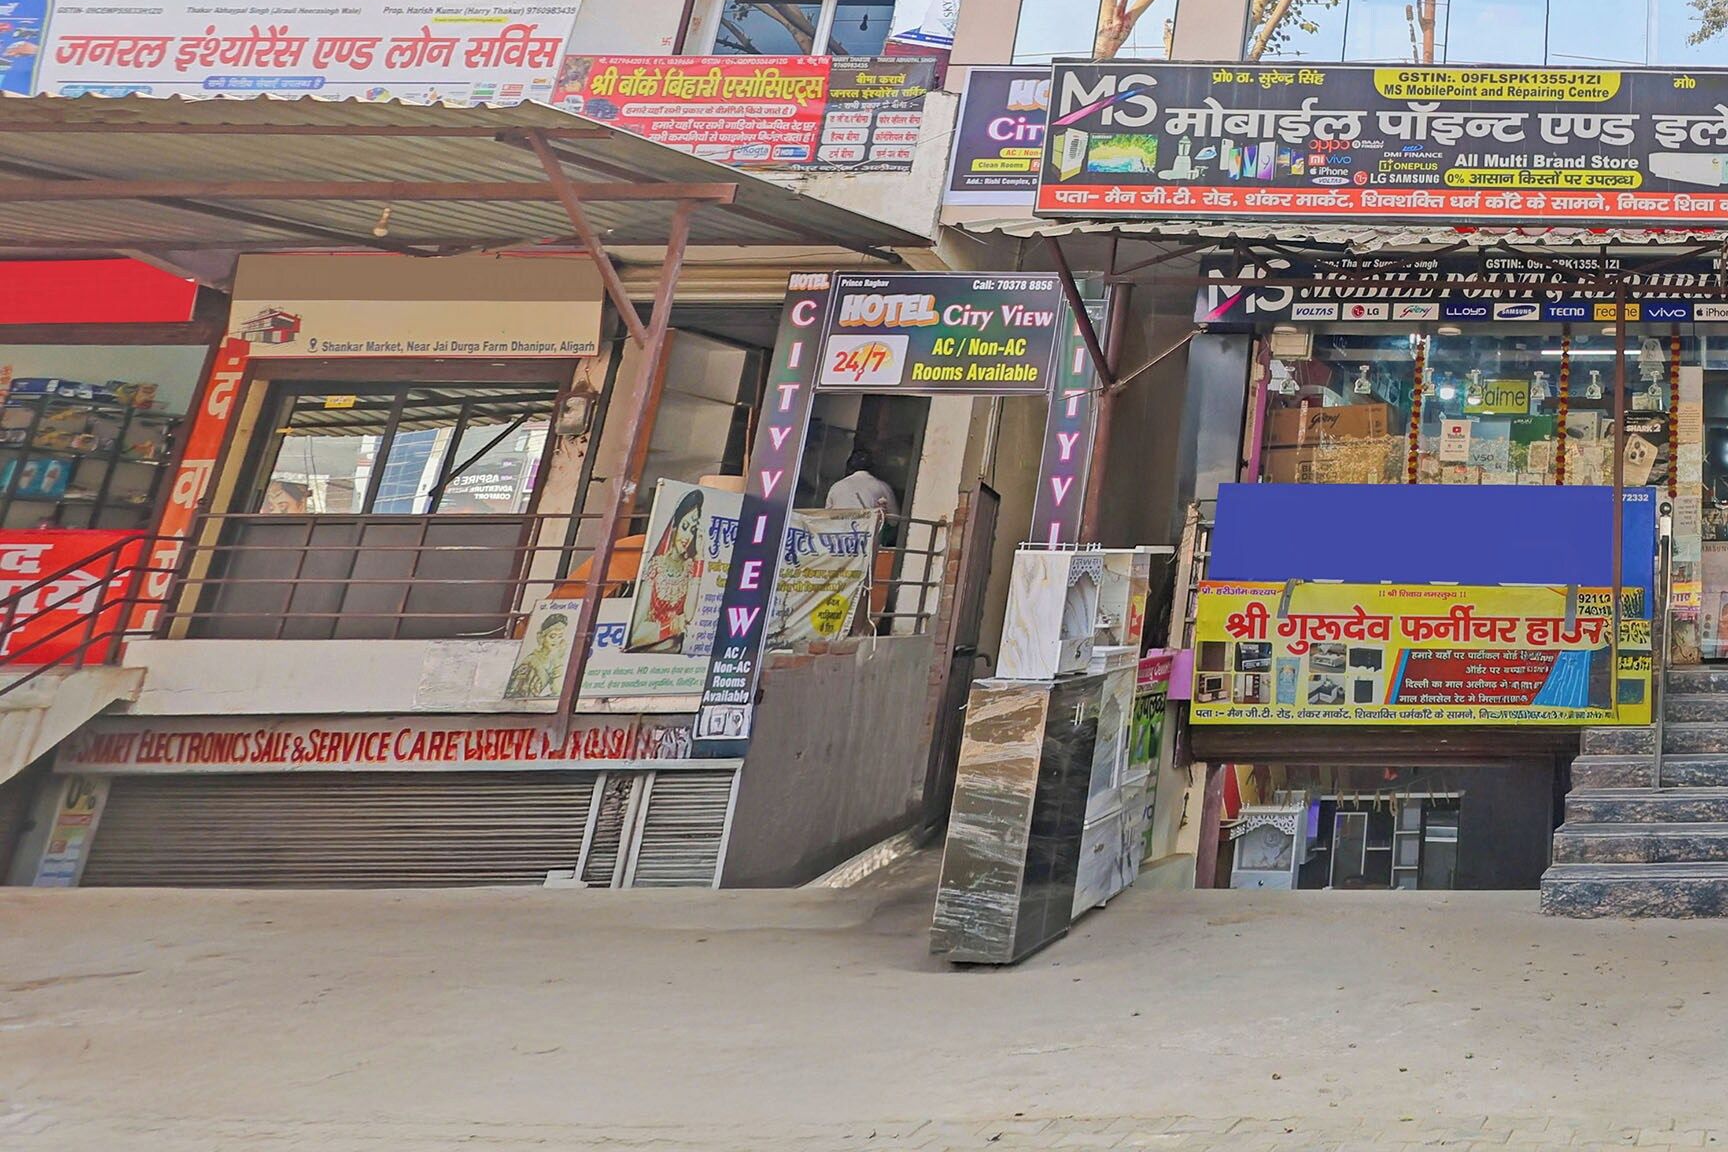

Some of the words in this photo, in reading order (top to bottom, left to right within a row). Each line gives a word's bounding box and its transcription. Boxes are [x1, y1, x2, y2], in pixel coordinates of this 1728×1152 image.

[383, 7, 404, 16] Prop.
[435, 7, 463, 15] Kumar
[493, 7, 526, 16] Thakur)
[55, 35, 175, 68] जनरल
[313, 36, 383, 70] एण्ड
[385, 24, 460, 70] लोन
[463, 23, 563, 69] सर्विस
[591, 66, 617, 96] श्री
[1298, 70, 1325, 85] सिंह
[1384, 84, 1402, 95] MS
[1406, 85, 1477, 96] MobilePoint
[1481, 86, 1502, 97] and
[1508, 87, 1563, 99] Repairing
[1568, 87, 1609, 98] Centre
[1056, 70, 1158, 128] MS
[1164, 96, 1368, 145] मोबाईल
[1376, 101, 1529, 146] पॉइन्ट
[1537, 113, 1640, 146] एण्ड
[1394, 162, 1438, 170] ONEPLUS
[1455, 153, 1478, 167] All
[1484, 154, 1527, 167] Multi
[1540, 155, 1588, 168] Brand
[1591, 155, 1639, 169] Store
[1318, 166, 1349, 176] iPhone
[1370, 173, 1386, 183] LG
[1389, 173, 1440, 184] SAMSUNG
[1447, 174, 1465, 184] 0%
[1469, 173, 1513, 185] आसान
[1564, 174, 1582, 185] पर
[1586, 175, 1635, 186] उपलब्ध
[1105, 186, 1135, 204] मैन
[1245, 190, 1292, 206] शंकर
[1361, 190, 1443, 209] शिवशक्ति
[1450, 192, 1482, 209] धर्म
[1526, 194, 1546, 209] के
[1551, 194, 1611, 211] सामने,
[1617, 194, 1670, 211] निकट
[1673, 194, 1714, 212] शिवा
[789, 273, 829, 290] HOTEL
[841, 279, 863, 288] Prince
[973, 280, 994, 290] Call:
[996, 280, 1027, 290] 70378
[839, 294, 939, 327] HOTEL
[1296, 307, 1334, 315] VOLTAS
[1549, 307, 1585, 316] TECNO
[1648, 307, 1686, 317] vivo
[322, 341, 363, 352] Shankar
[366, 341, 403, 353] Market,
[407, 341, 429, 352] Near
[432, 341, 448, 352] Jai
[451, 341, 480, 354] Durga
[482, 341, 508, 352] Farm
[511, 341, 556, 354] Dhanipur,
[559, 340, 595, 354] Aligarh
[932, 337, 956, 355] AC
[968, 338, 1027, 356] Non-AC
[832, 342, 887, 382] 24/7
[912, 363, 966, 381] Rooms
[967, 364, 1038, 381] Available
[1652, 424, 1661, 433] 2
[1225, 601, 1270, 640] श्री
[1400, 605, 1520, 645] फर्नीचर
[725, 646, 739, 660] AC
[713, 661, 751, 674] Non-AC
[713, 676, 746, 689] Rooms
[251, 728, 291, 763] SALE
[291, 735, 305, 762] &
[305, 729, 388, 763] SERVICE
[393, 728, 458, 761] CARE
